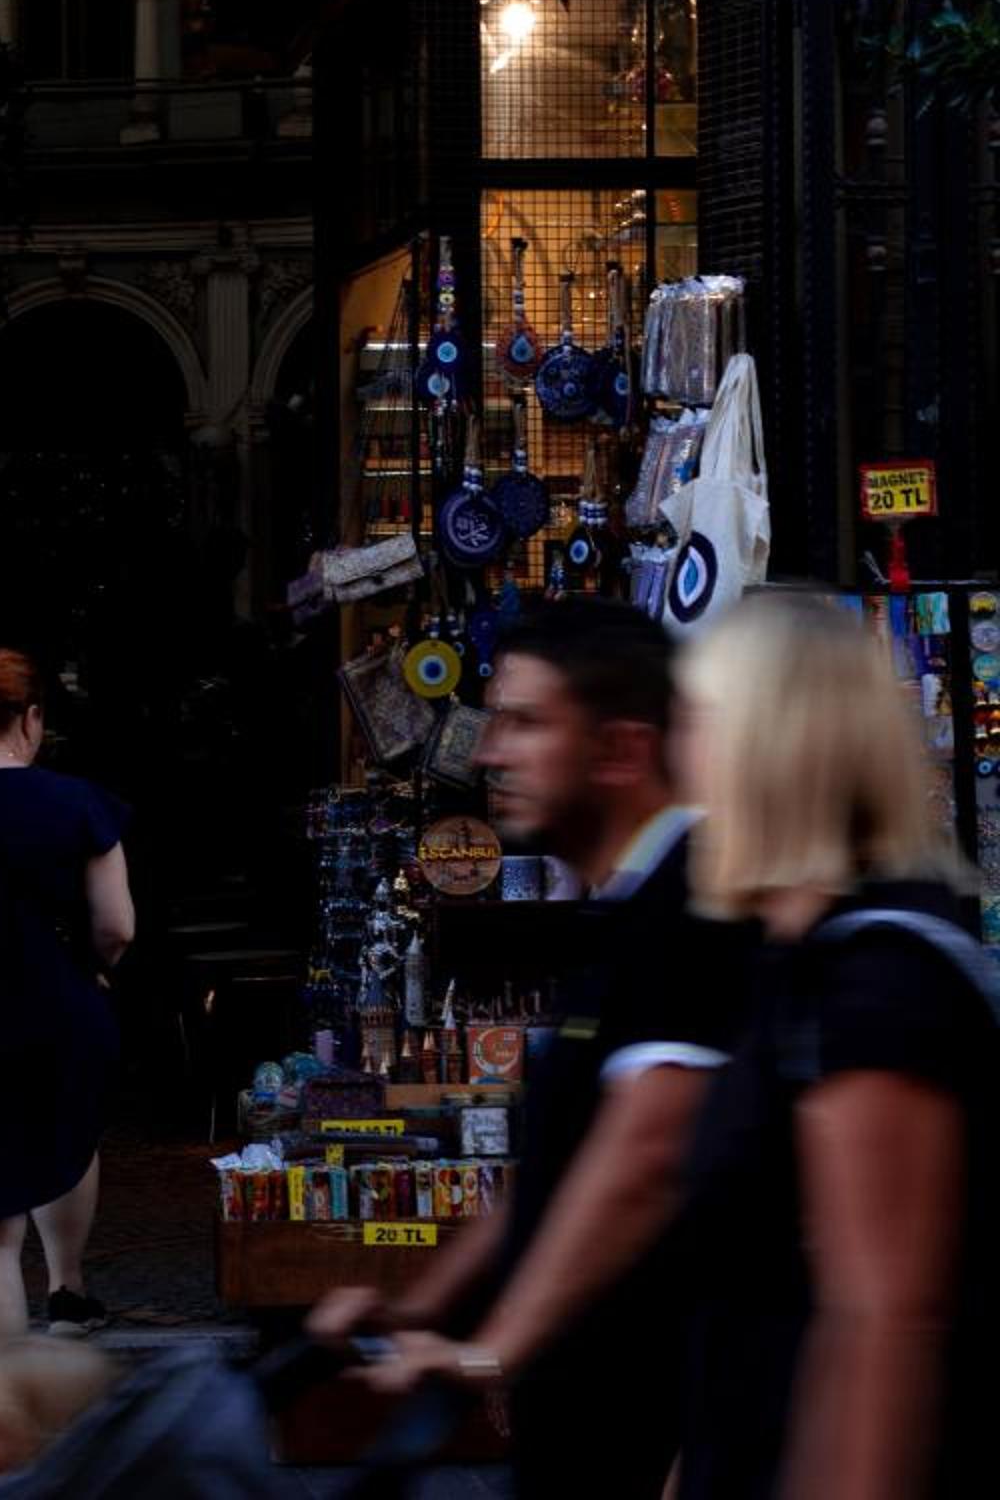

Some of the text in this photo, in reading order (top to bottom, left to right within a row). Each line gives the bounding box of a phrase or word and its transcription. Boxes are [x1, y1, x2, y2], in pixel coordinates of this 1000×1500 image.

[871, 487, 928, 510] 20 TL
[375, 1228, 426, 1242] 20 TL
